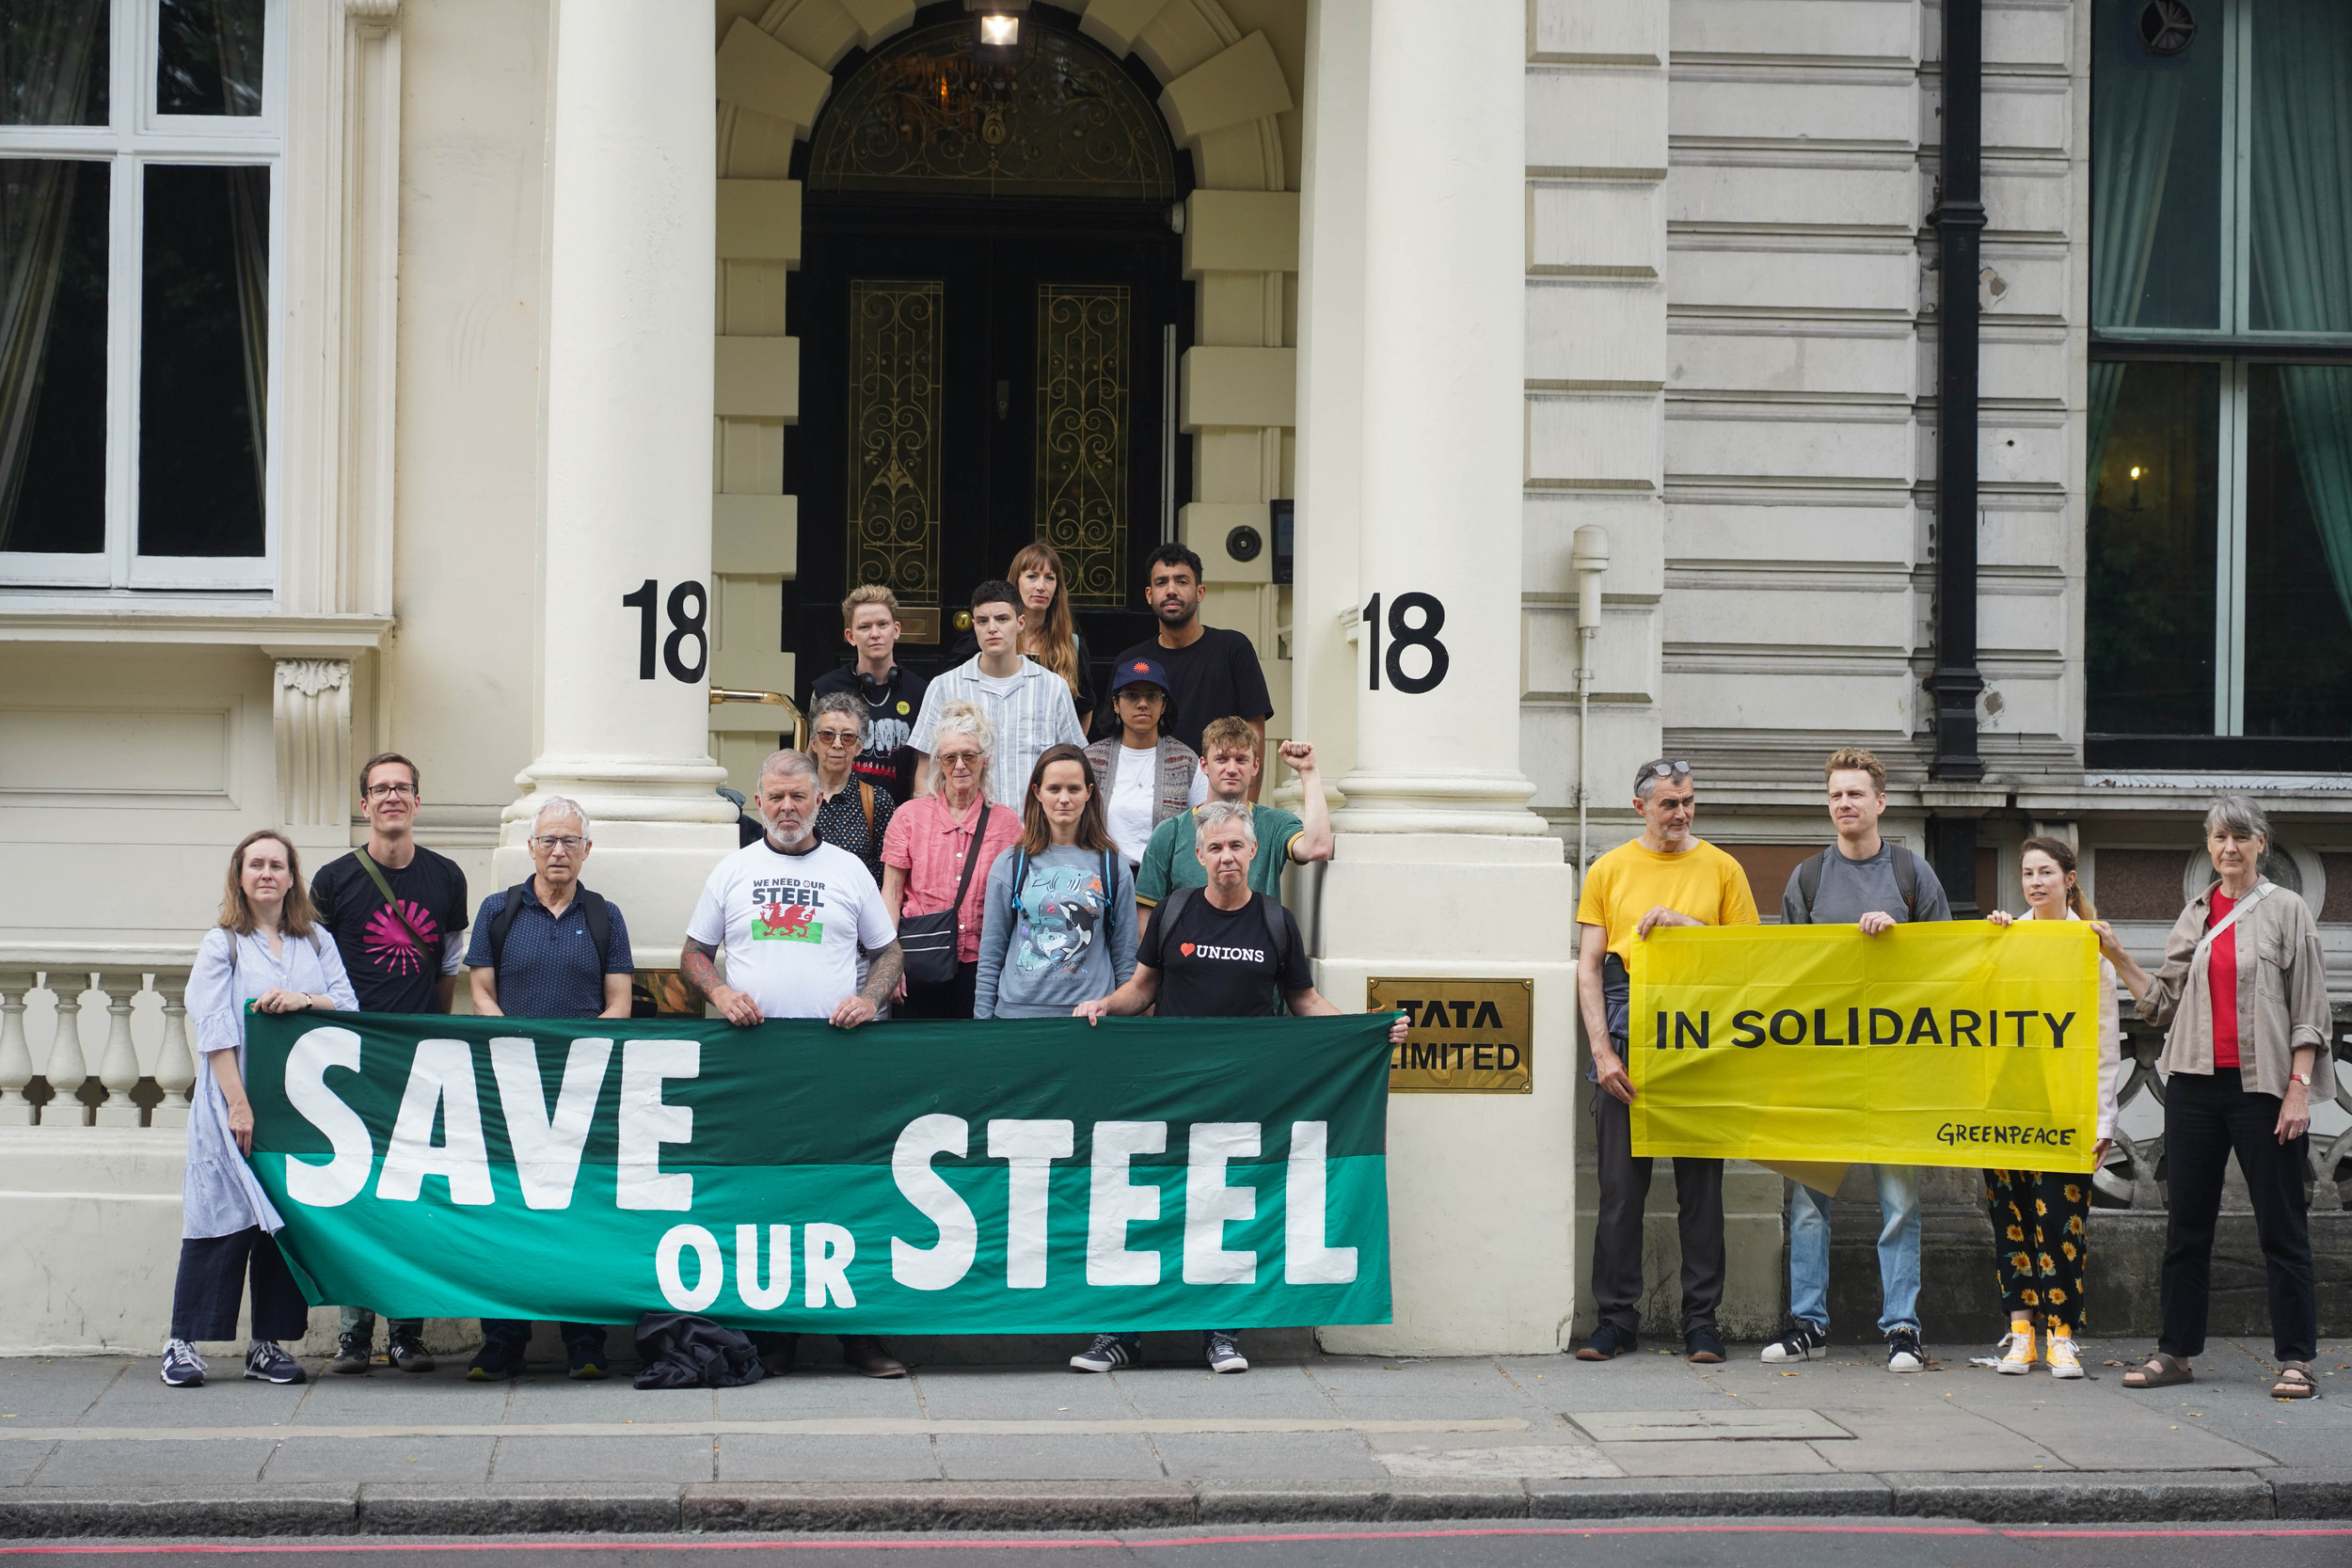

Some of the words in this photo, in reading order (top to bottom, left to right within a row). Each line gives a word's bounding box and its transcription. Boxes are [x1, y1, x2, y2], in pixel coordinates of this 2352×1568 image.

[623, 578, 708, 684] 18
[1362, 593, 1450, 694] 18
[752, 887, 825, 908] STEEL
[771, 878, 801, 887] NEED
[1196, 944, 1264, 963] UNIONS
[1396, 1000, 1503, 1029] TATA
[1656, 1010, 1709, 1050] IN
[1731, 1006, 2076, 1049] SOLIDARITY
[1391, 1042, 1520, 1070] IMITED
[284, 1026, 702, 1212] SAVE
[1936, 1122, 2077, 1147] GREENPEACE
[890, 1113, 1359, 1291] STEEL
[655, 1222, 857, 1313] OUR
